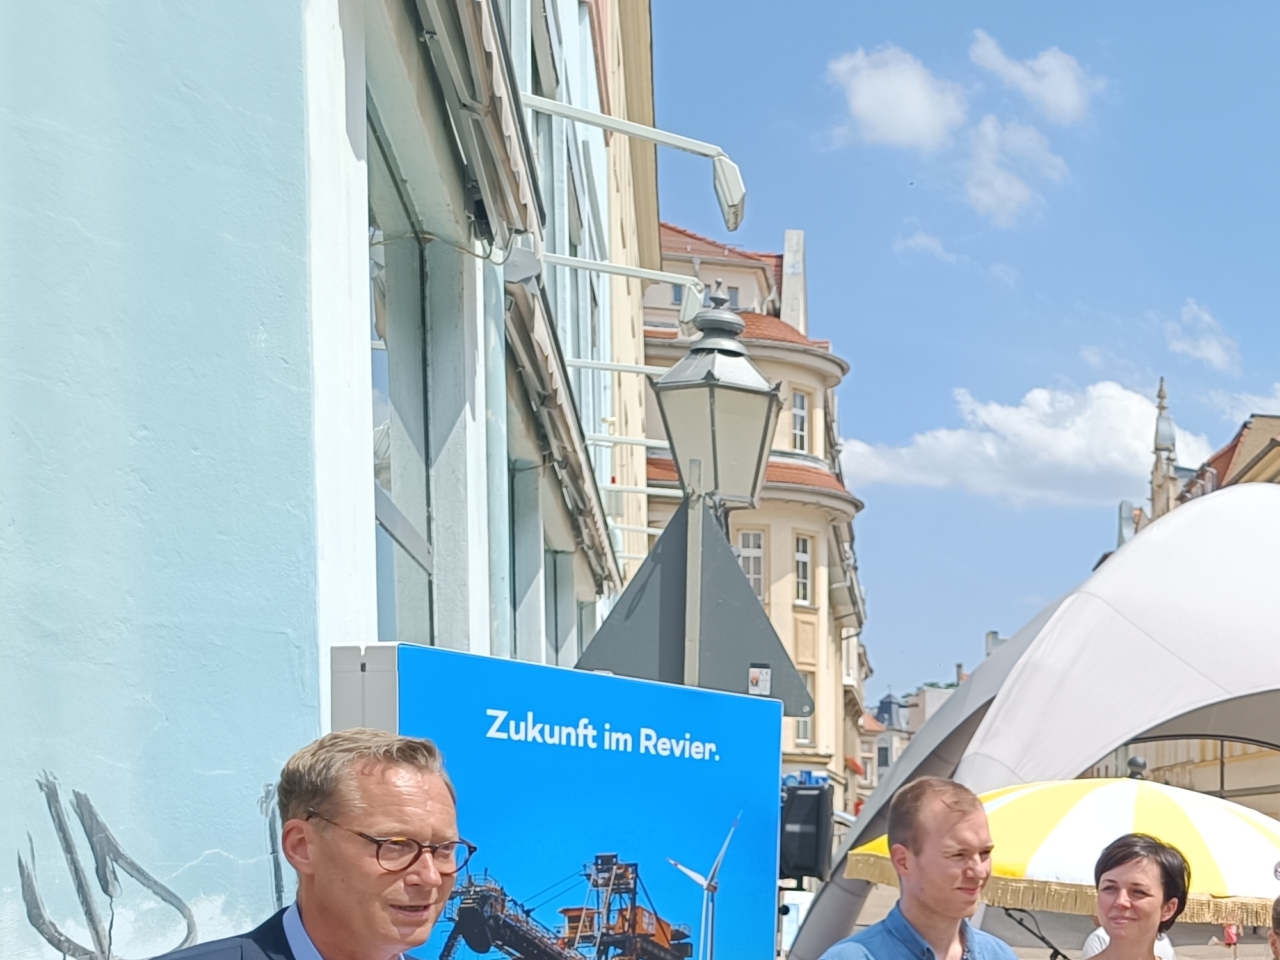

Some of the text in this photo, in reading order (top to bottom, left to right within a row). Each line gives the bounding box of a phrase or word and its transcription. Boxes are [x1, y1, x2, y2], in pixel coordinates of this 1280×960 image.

[485, 708, 720, 762] Zukunft im Revier.
